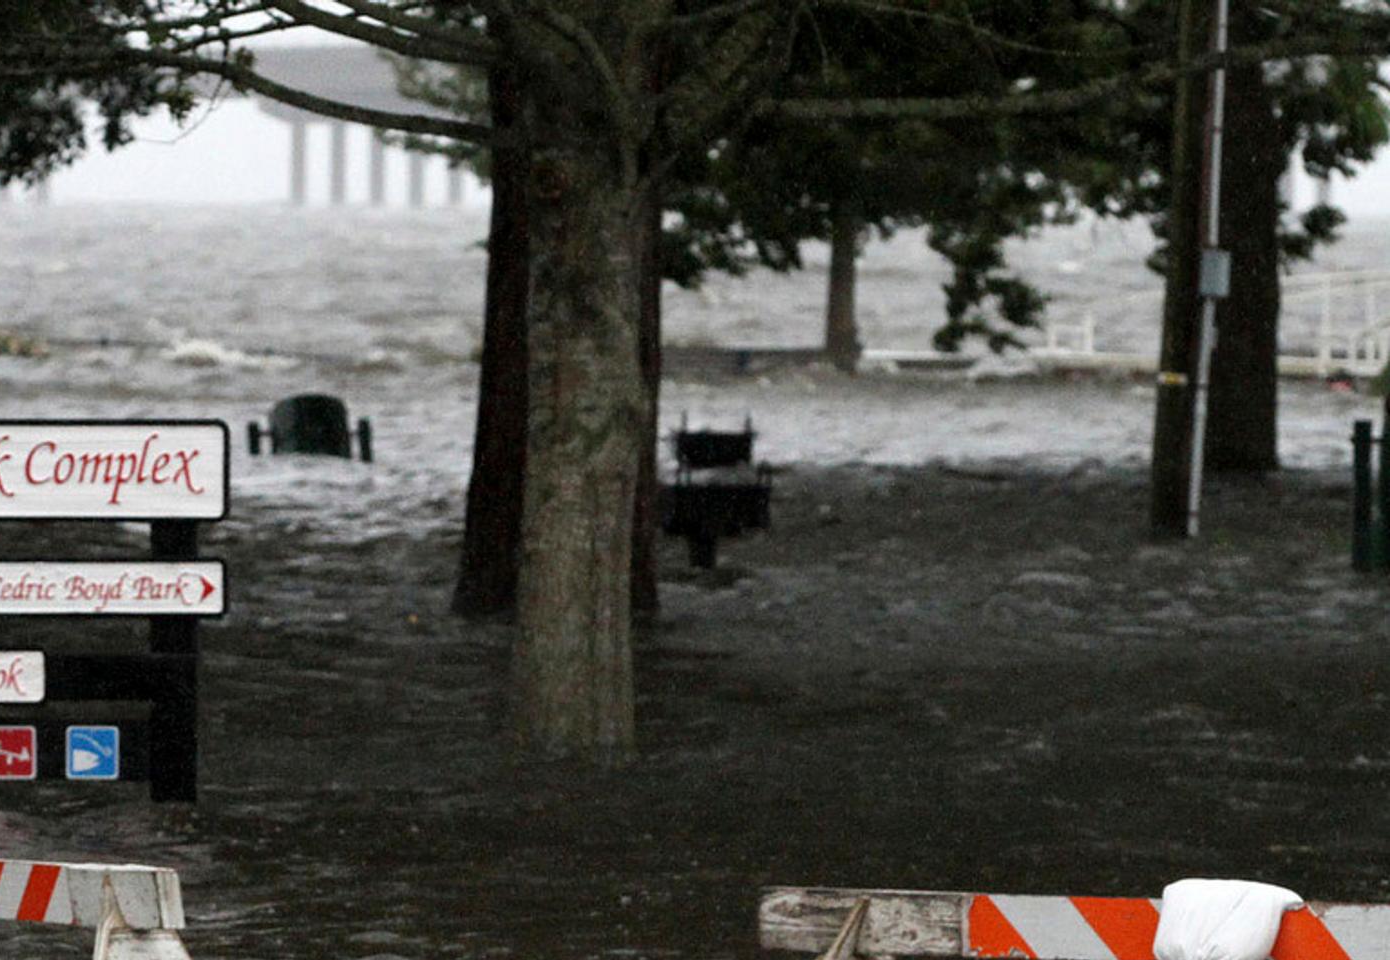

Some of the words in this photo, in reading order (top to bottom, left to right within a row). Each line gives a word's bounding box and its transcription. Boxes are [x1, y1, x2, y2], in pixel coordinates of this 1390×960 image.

[24, 434, 203, 505] Complex
[65, 572, 129, 613] Boyd
[133, 572, 194, 606] Park
